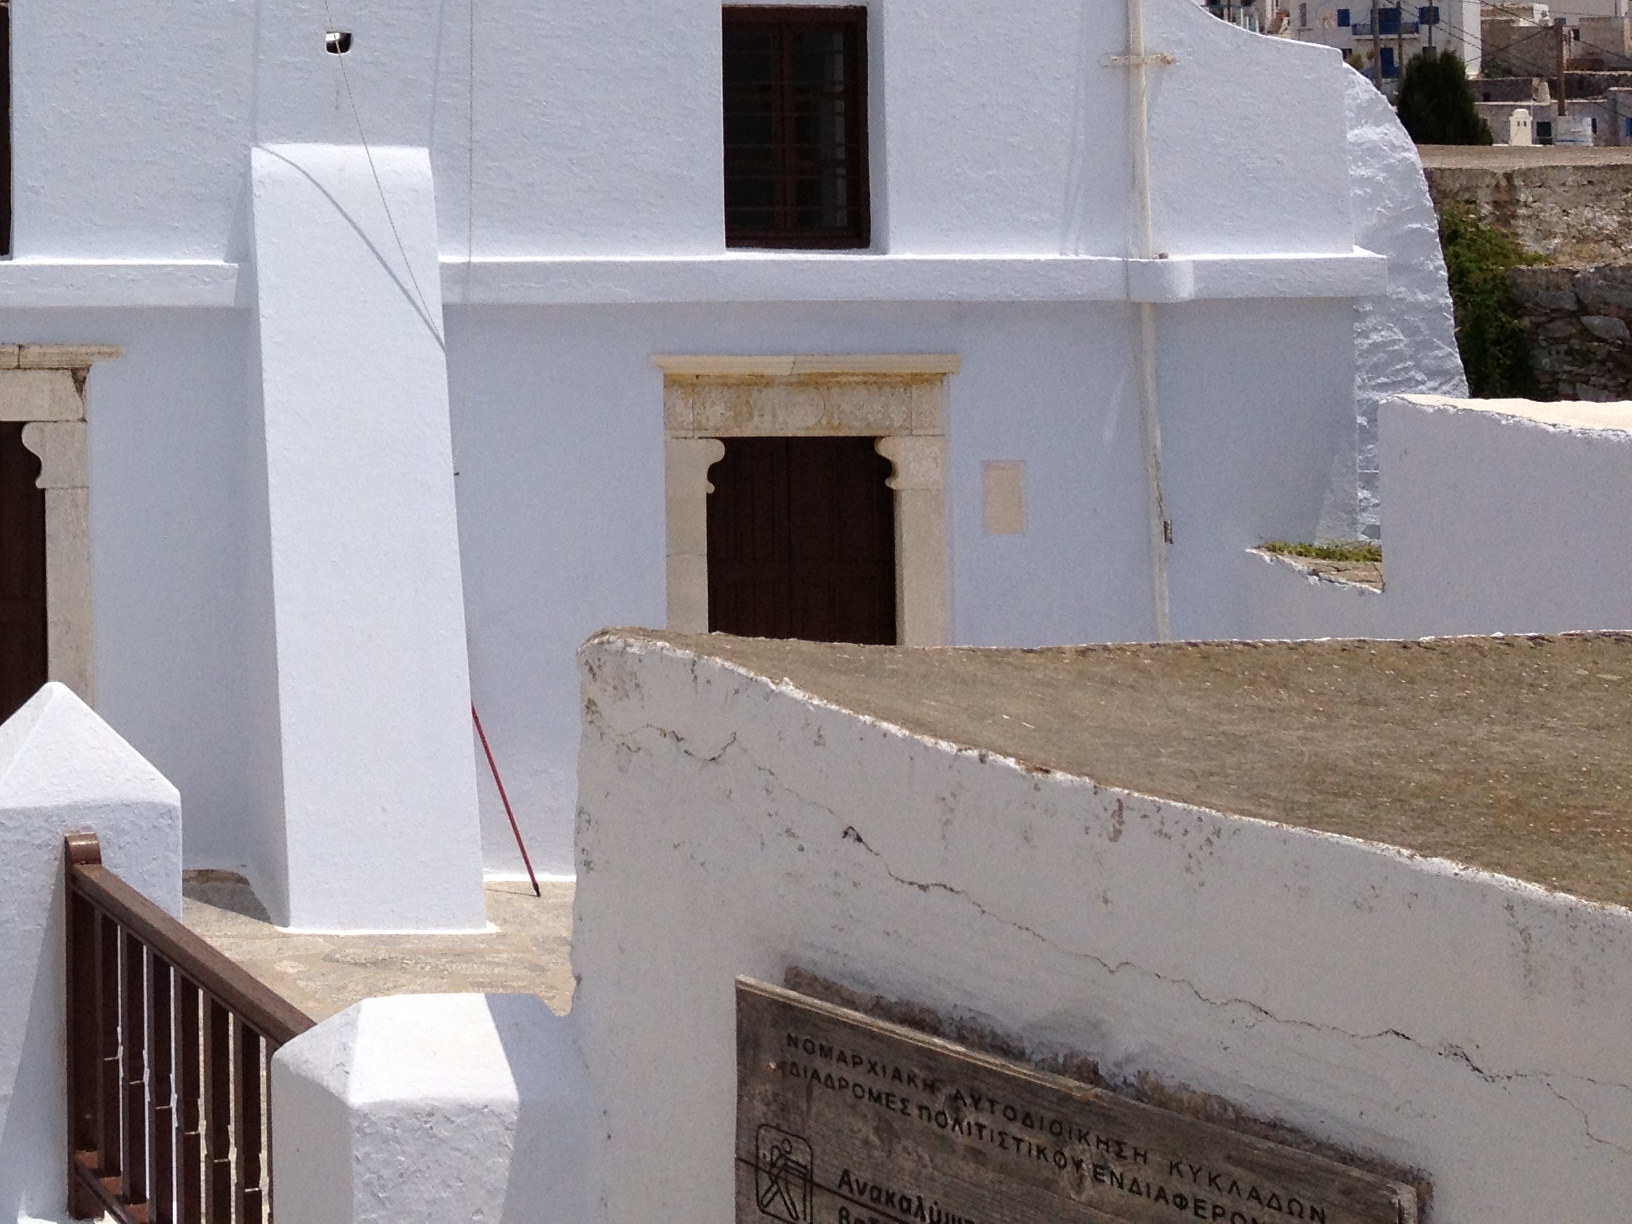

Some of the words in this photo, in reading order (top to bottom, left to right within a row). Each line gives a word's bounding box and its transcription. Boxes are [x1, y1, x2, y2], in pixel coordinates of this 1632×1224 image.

[786, 1032, 938, 1095] ΝΟΜΑΡΧΙΑΚΗ
[954, 1088, 1148, 1165] ΑΥΤΟΔΙΟΙΚΗΣΗ
[1168, 1160, 1327, 1224] ΚΥΚΛΑΔΩΝ
[789, 1060, 911, 1117] ΔΙΑΔΡΟΜΕΣ
[918, 1104, 1085, 1174] ΠΟΛΙΤΙΣΤΙΚΟΥ
